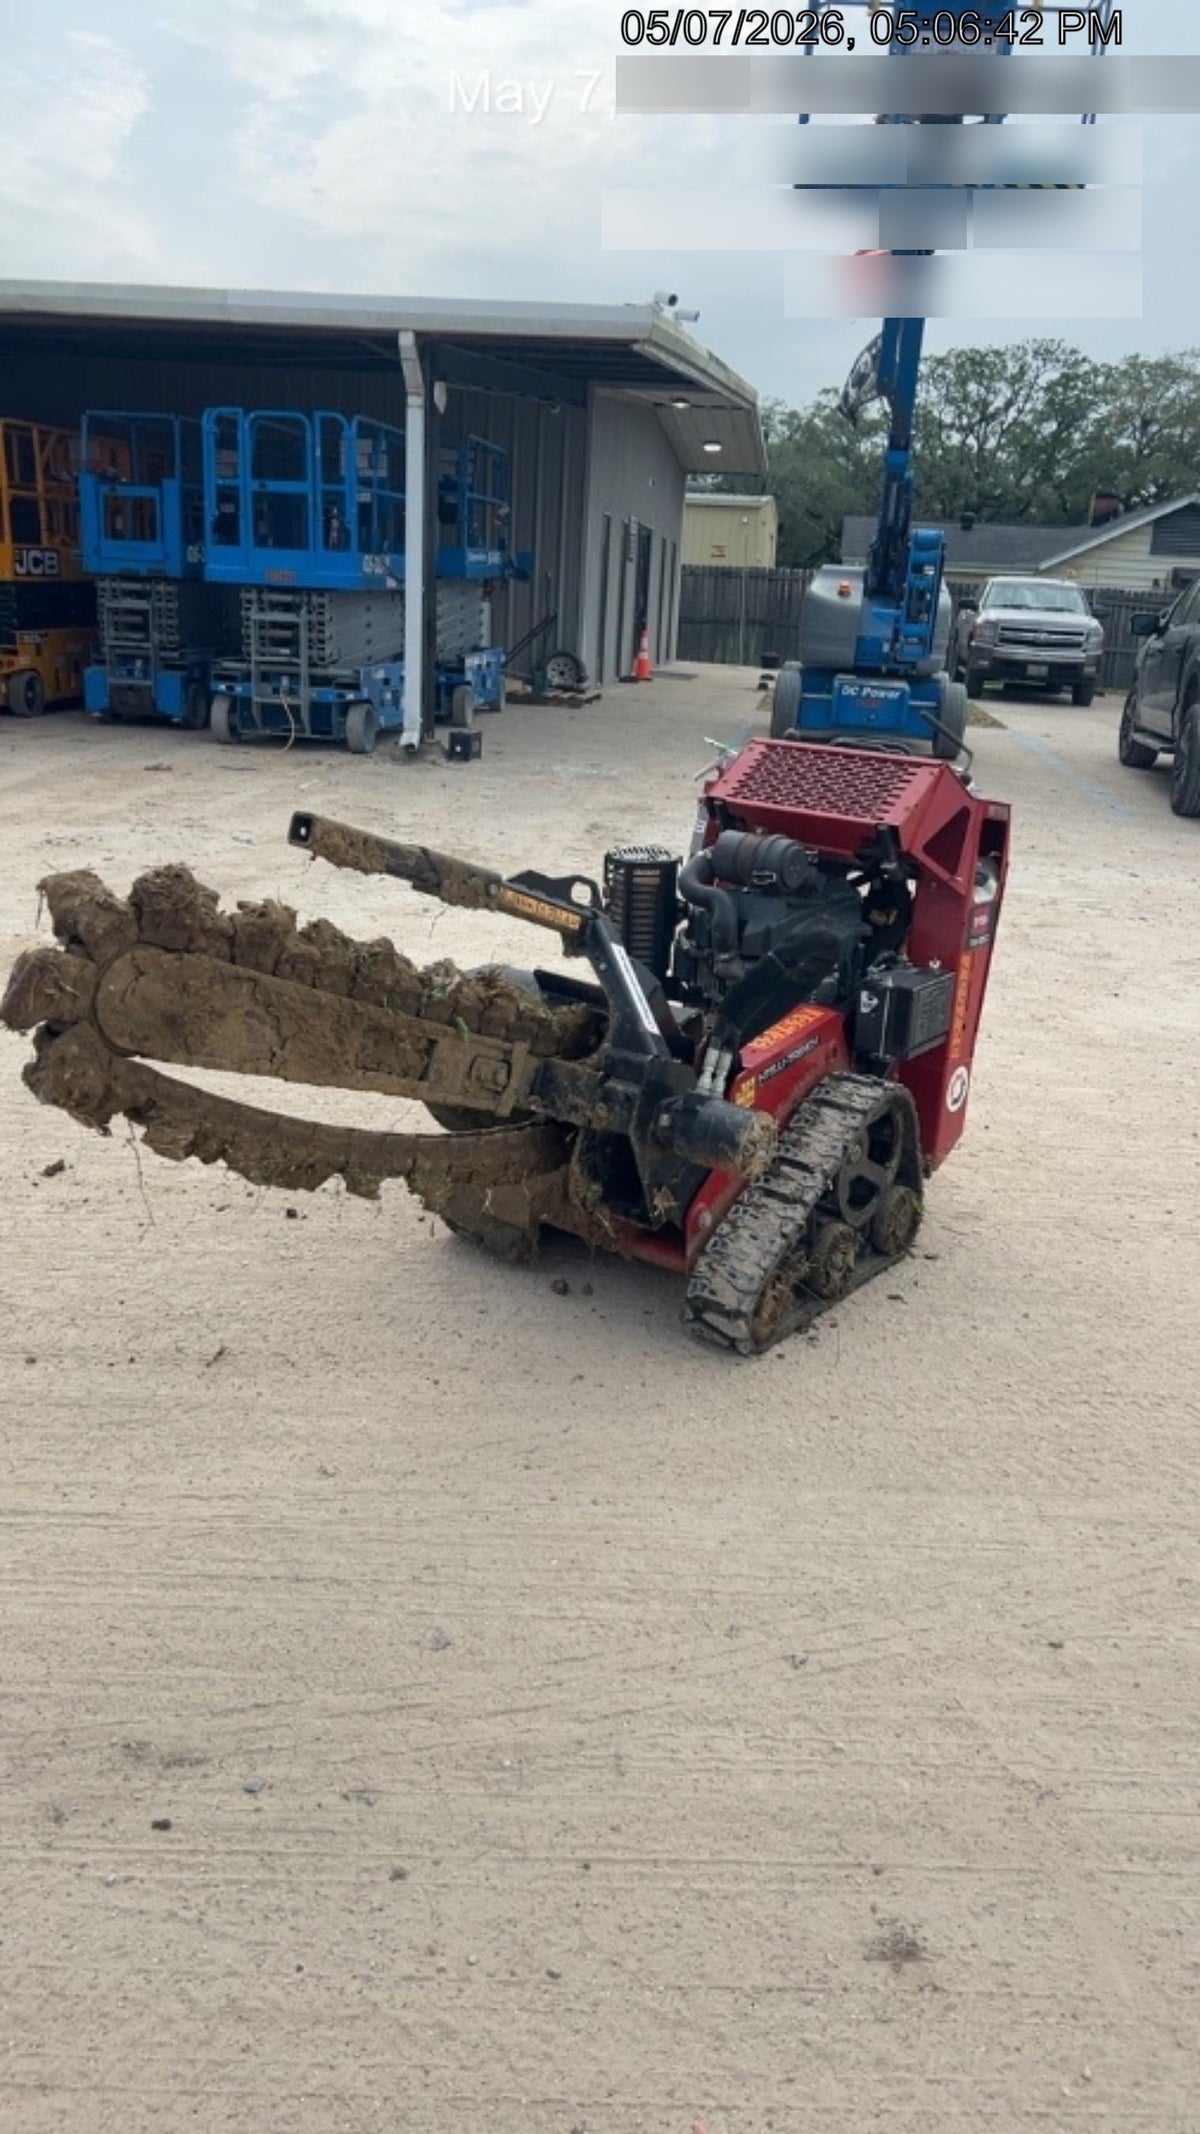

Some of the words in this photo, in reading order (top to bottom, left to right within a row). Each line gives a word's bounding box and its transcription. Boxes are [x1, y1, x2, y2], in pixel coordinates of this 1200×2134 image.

[15, 549, 60, 575] JCB
[841, 684, 860, 696] DC
[861, 686, 901, 700] Power
